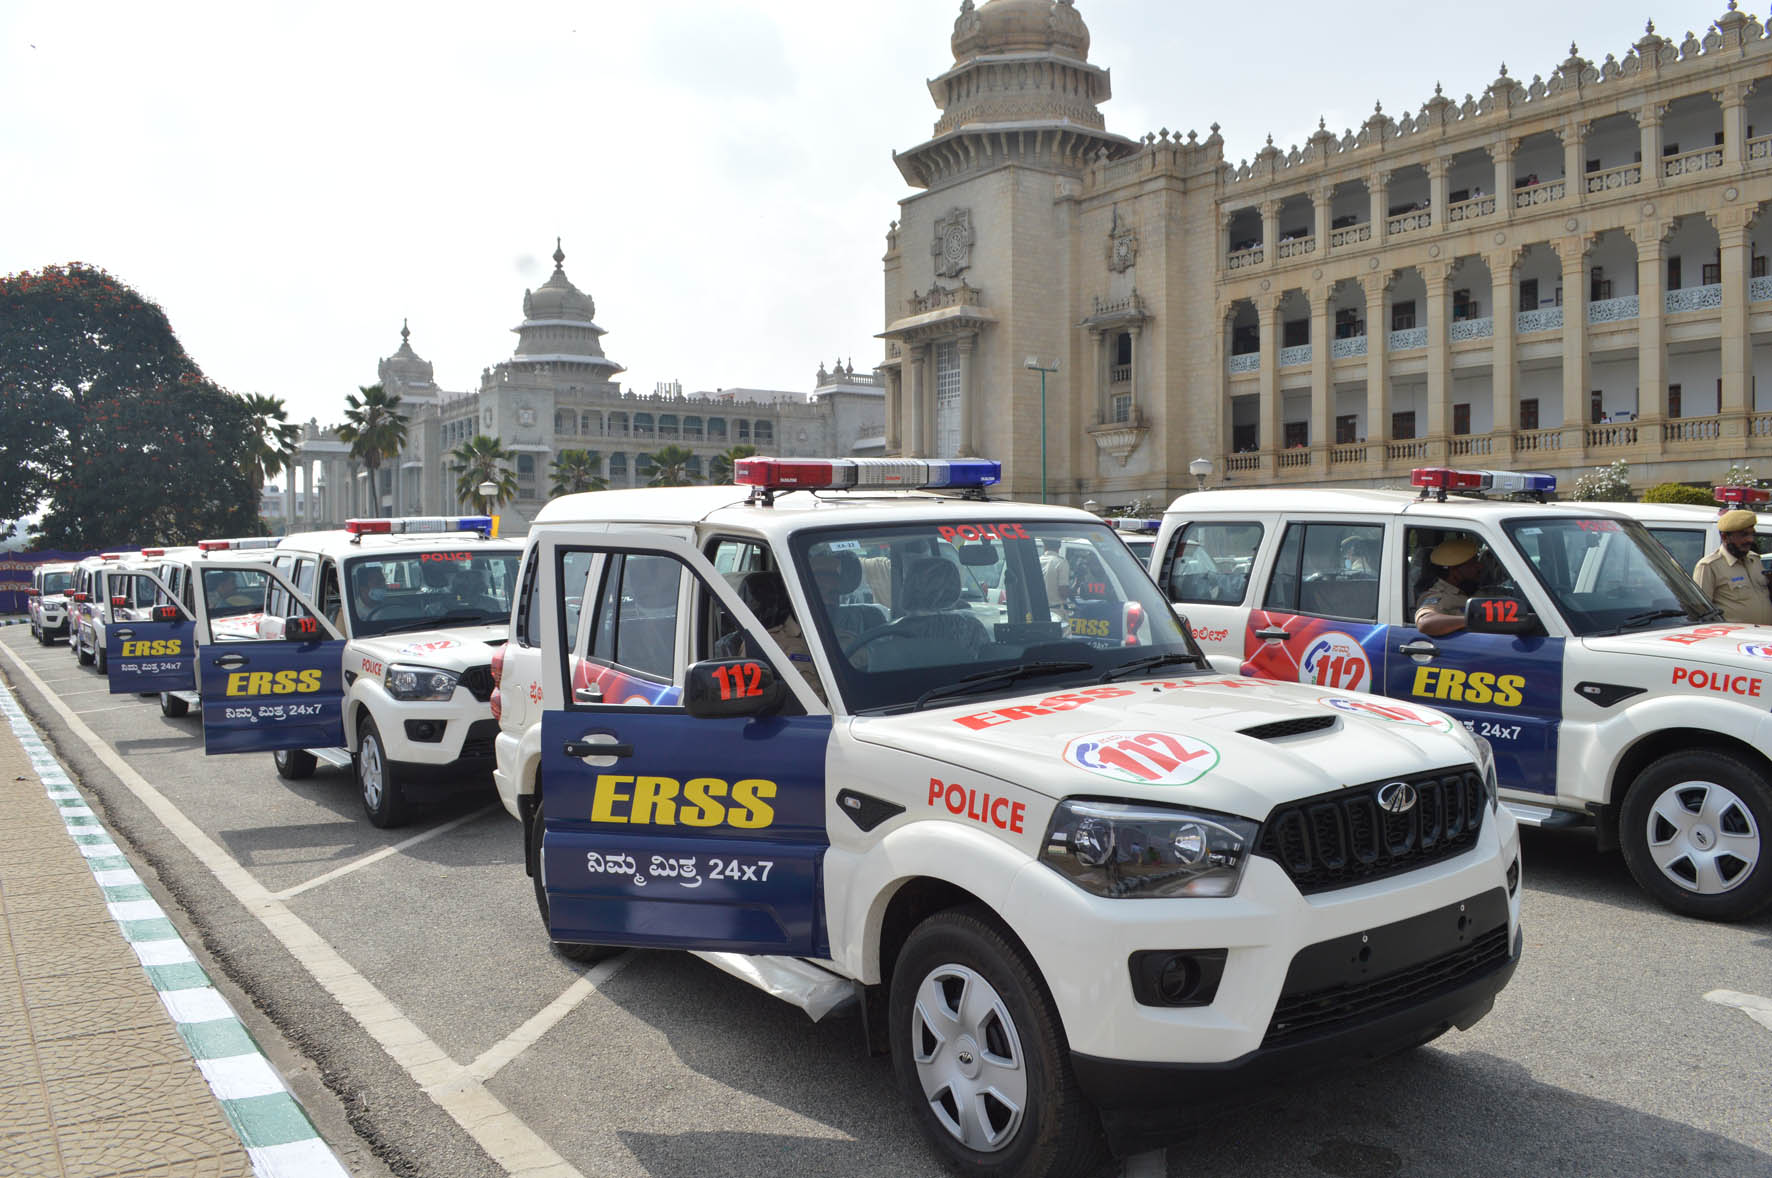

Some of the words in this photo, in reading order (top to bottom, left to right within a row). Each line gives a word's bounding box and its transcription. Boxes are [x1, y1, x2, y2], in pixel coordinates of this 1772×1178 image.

[937, 523, 1031, 542] POLICE
[420, 552, 473, 563] POLICE
[112, 597, 125, 605] 112
[160, 607, 176, 617] 112
[1481, 600, 1519, 623] 112
[298, 617, 317, 632] 112
[122, 639, 182, 657] ERSS
[161, 662, 181, 670] 24x7
[362, 658, 382, 676] POLICE
[1316, 655, 1365, 691] 112
[226, 669, 322, 696] ERSS
[712, 662, 764, 700] 112
[1412, 666, 1526, 707] ERSS
[1671, 666, 1763, 697] POLICE
[226, 707, 258, 722] ನಿಮ್ಮ
[258, 705, 287, 720] ಮಿತ್ರ
[289, 704, 322, 715] 24x7
[952, 687, 1136, 730] ERSS
[1481, 722, 1521, 740] 24x7
[1098, 732, 1211, 781] 112
[591, 775, 777, 829] ERSS
[927, 777, 1026, 835] POLICE
[587, 852, 647, 887] ನಿಮ್ಮ
[650, 855, 703, 888] ಮಿತ್ರ
[708, 859, 774, 882] 24x7
